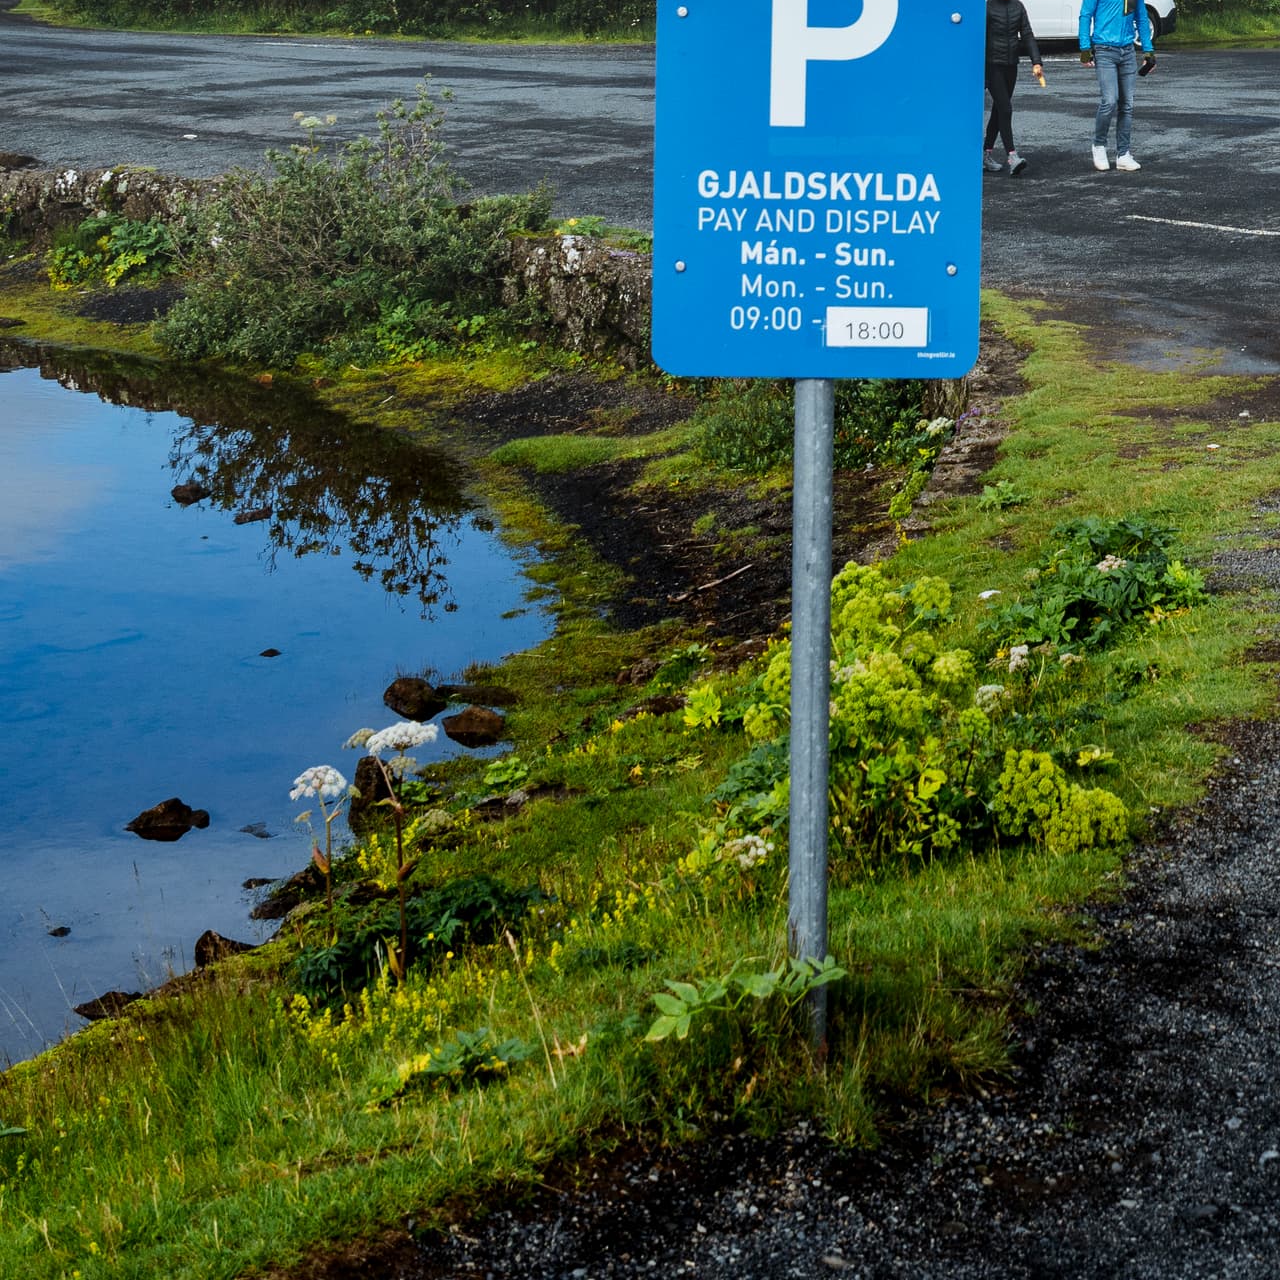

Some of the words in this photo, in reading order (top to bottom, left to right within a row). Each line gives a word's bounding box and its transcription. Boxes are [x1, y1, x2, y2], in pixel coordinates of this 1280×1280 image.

[698, 169, 941, 202] GJALDSKYLDA
[698, 207, 748, 232] PAY
[755, 208, 815, 233] AND
[826, 209, 940, 234] DISPLAY
[741, 240, 806, 266] Mán.
[835, 242, 895, 267] Sun.
[741, 273, 804, 298] Mon.
[835, 275, 893, 299] Sun.
[730, 305, 802, 331] 09:00
[845, 321, 904, 340] 18:00
